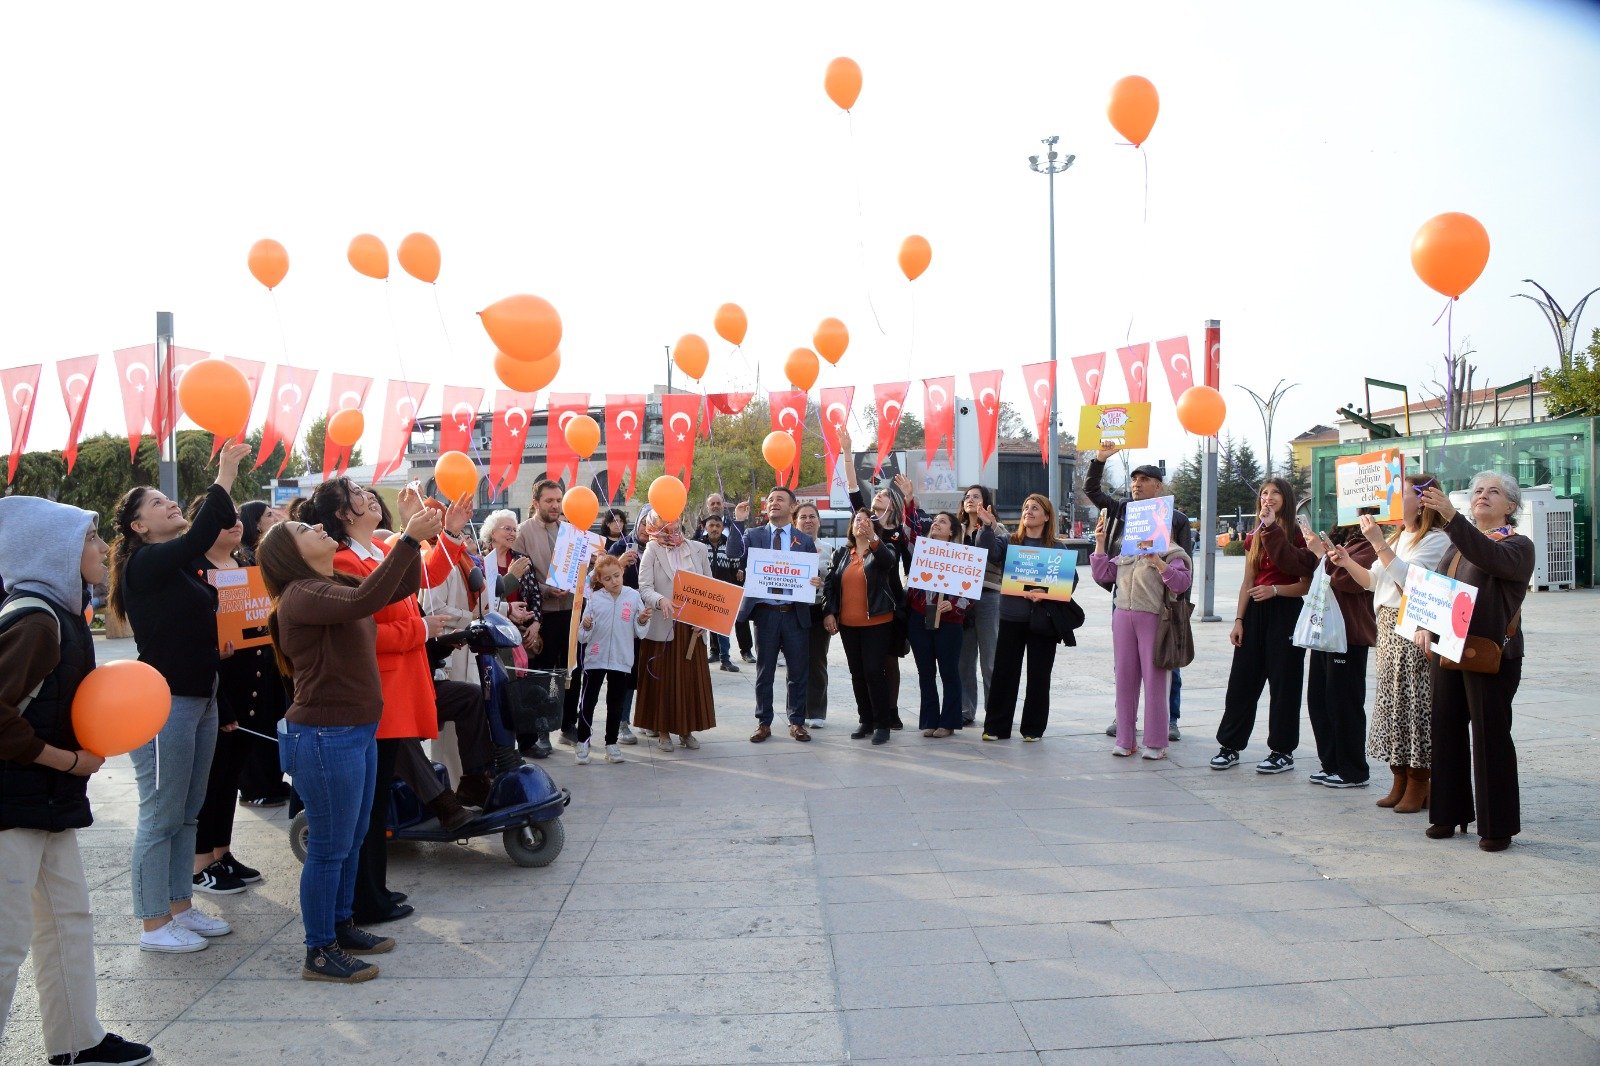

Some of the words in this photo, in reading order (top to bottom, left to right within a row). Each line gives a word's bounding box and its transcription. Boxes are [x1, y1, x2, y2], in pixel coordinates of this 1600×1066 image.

[1359, 465, 1381, 475] birlikte
[1342, 487, 1366, 496] kansere
[562, 542, 574, 574] HAYATIN
[567, 536, 582, 584] RENKLERİYLE
[928, 546, 974, 562] BİRLİKTE
[1018, 552, 1039, 561] birgün
[763, 564, 790, 576] GÜÇLÜ
[915, 556, 982, 577] İYİLEŞECEĞİZ
[1015, 566, 1039, 575] hergün
[1047, 565, 1059, 575] SE
[1045, 575, 1058, 585] MA
[220, 587, 250, 600] ERKEN
[683, 585, 707, 597] LÖSEMİ
[708, 592, 726, 604] DEĞİL
[1410, 586, 1427, 598] Hayat
[220, 600, 244, 613] TANI
[244, 596, 271, 609] HAYA
[1409, 594, 1428, 606] Kanser
[692, 598, 730, 615] BULAŞICIDIR
[245, 608, 270, 621] KURT
